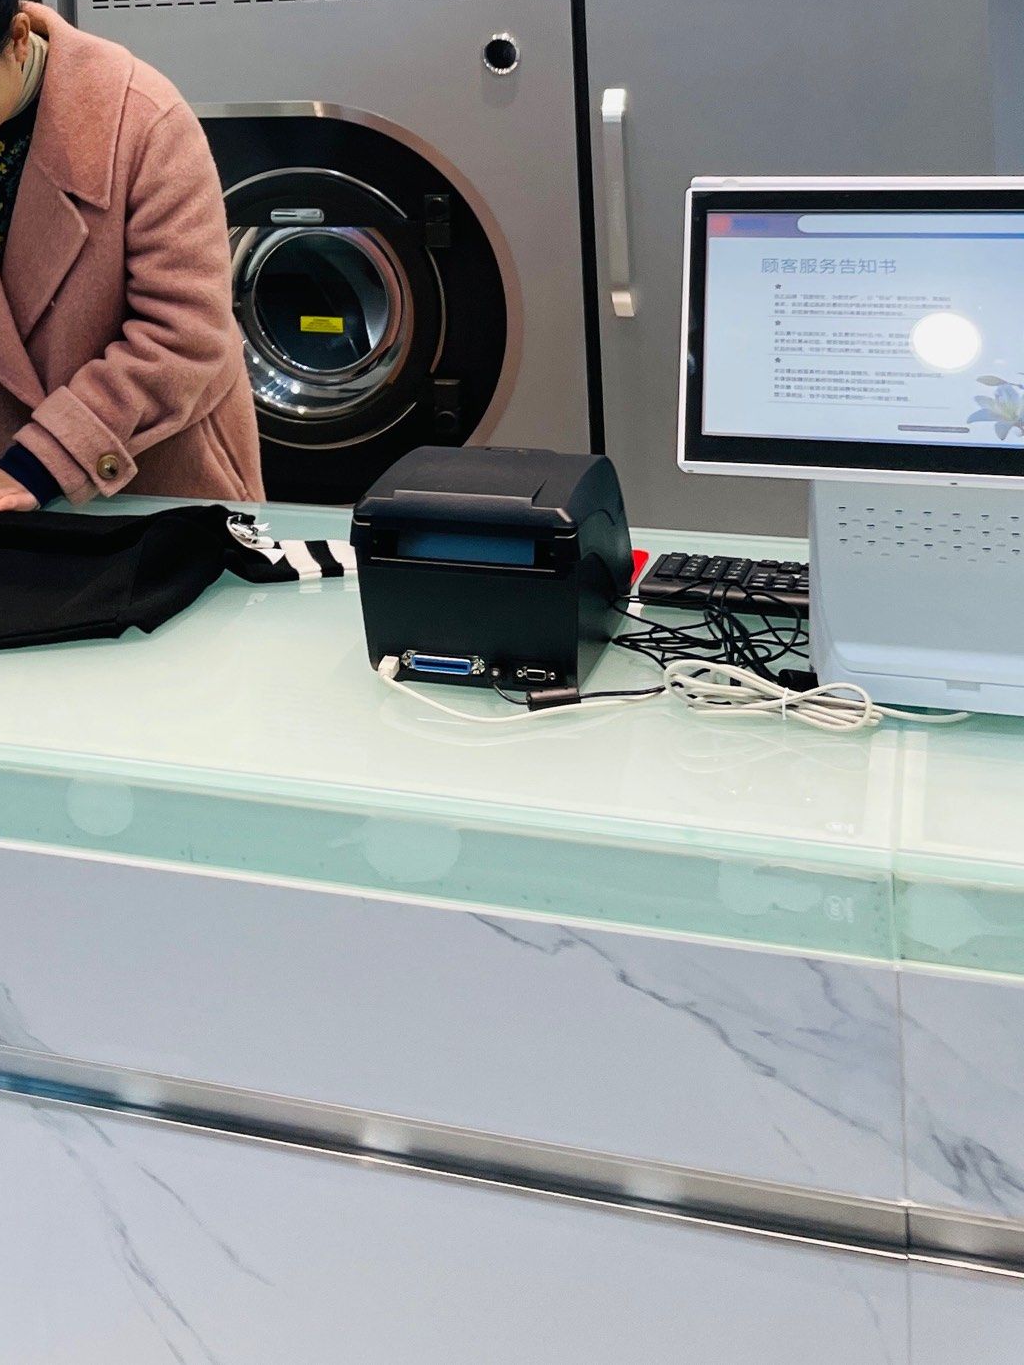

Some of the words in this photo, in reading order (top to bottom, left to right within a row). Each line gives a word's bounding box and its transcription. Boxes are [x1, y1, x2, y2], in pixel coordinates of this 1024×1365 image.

[760, 257, 898, 275] 顾客服务告知书
